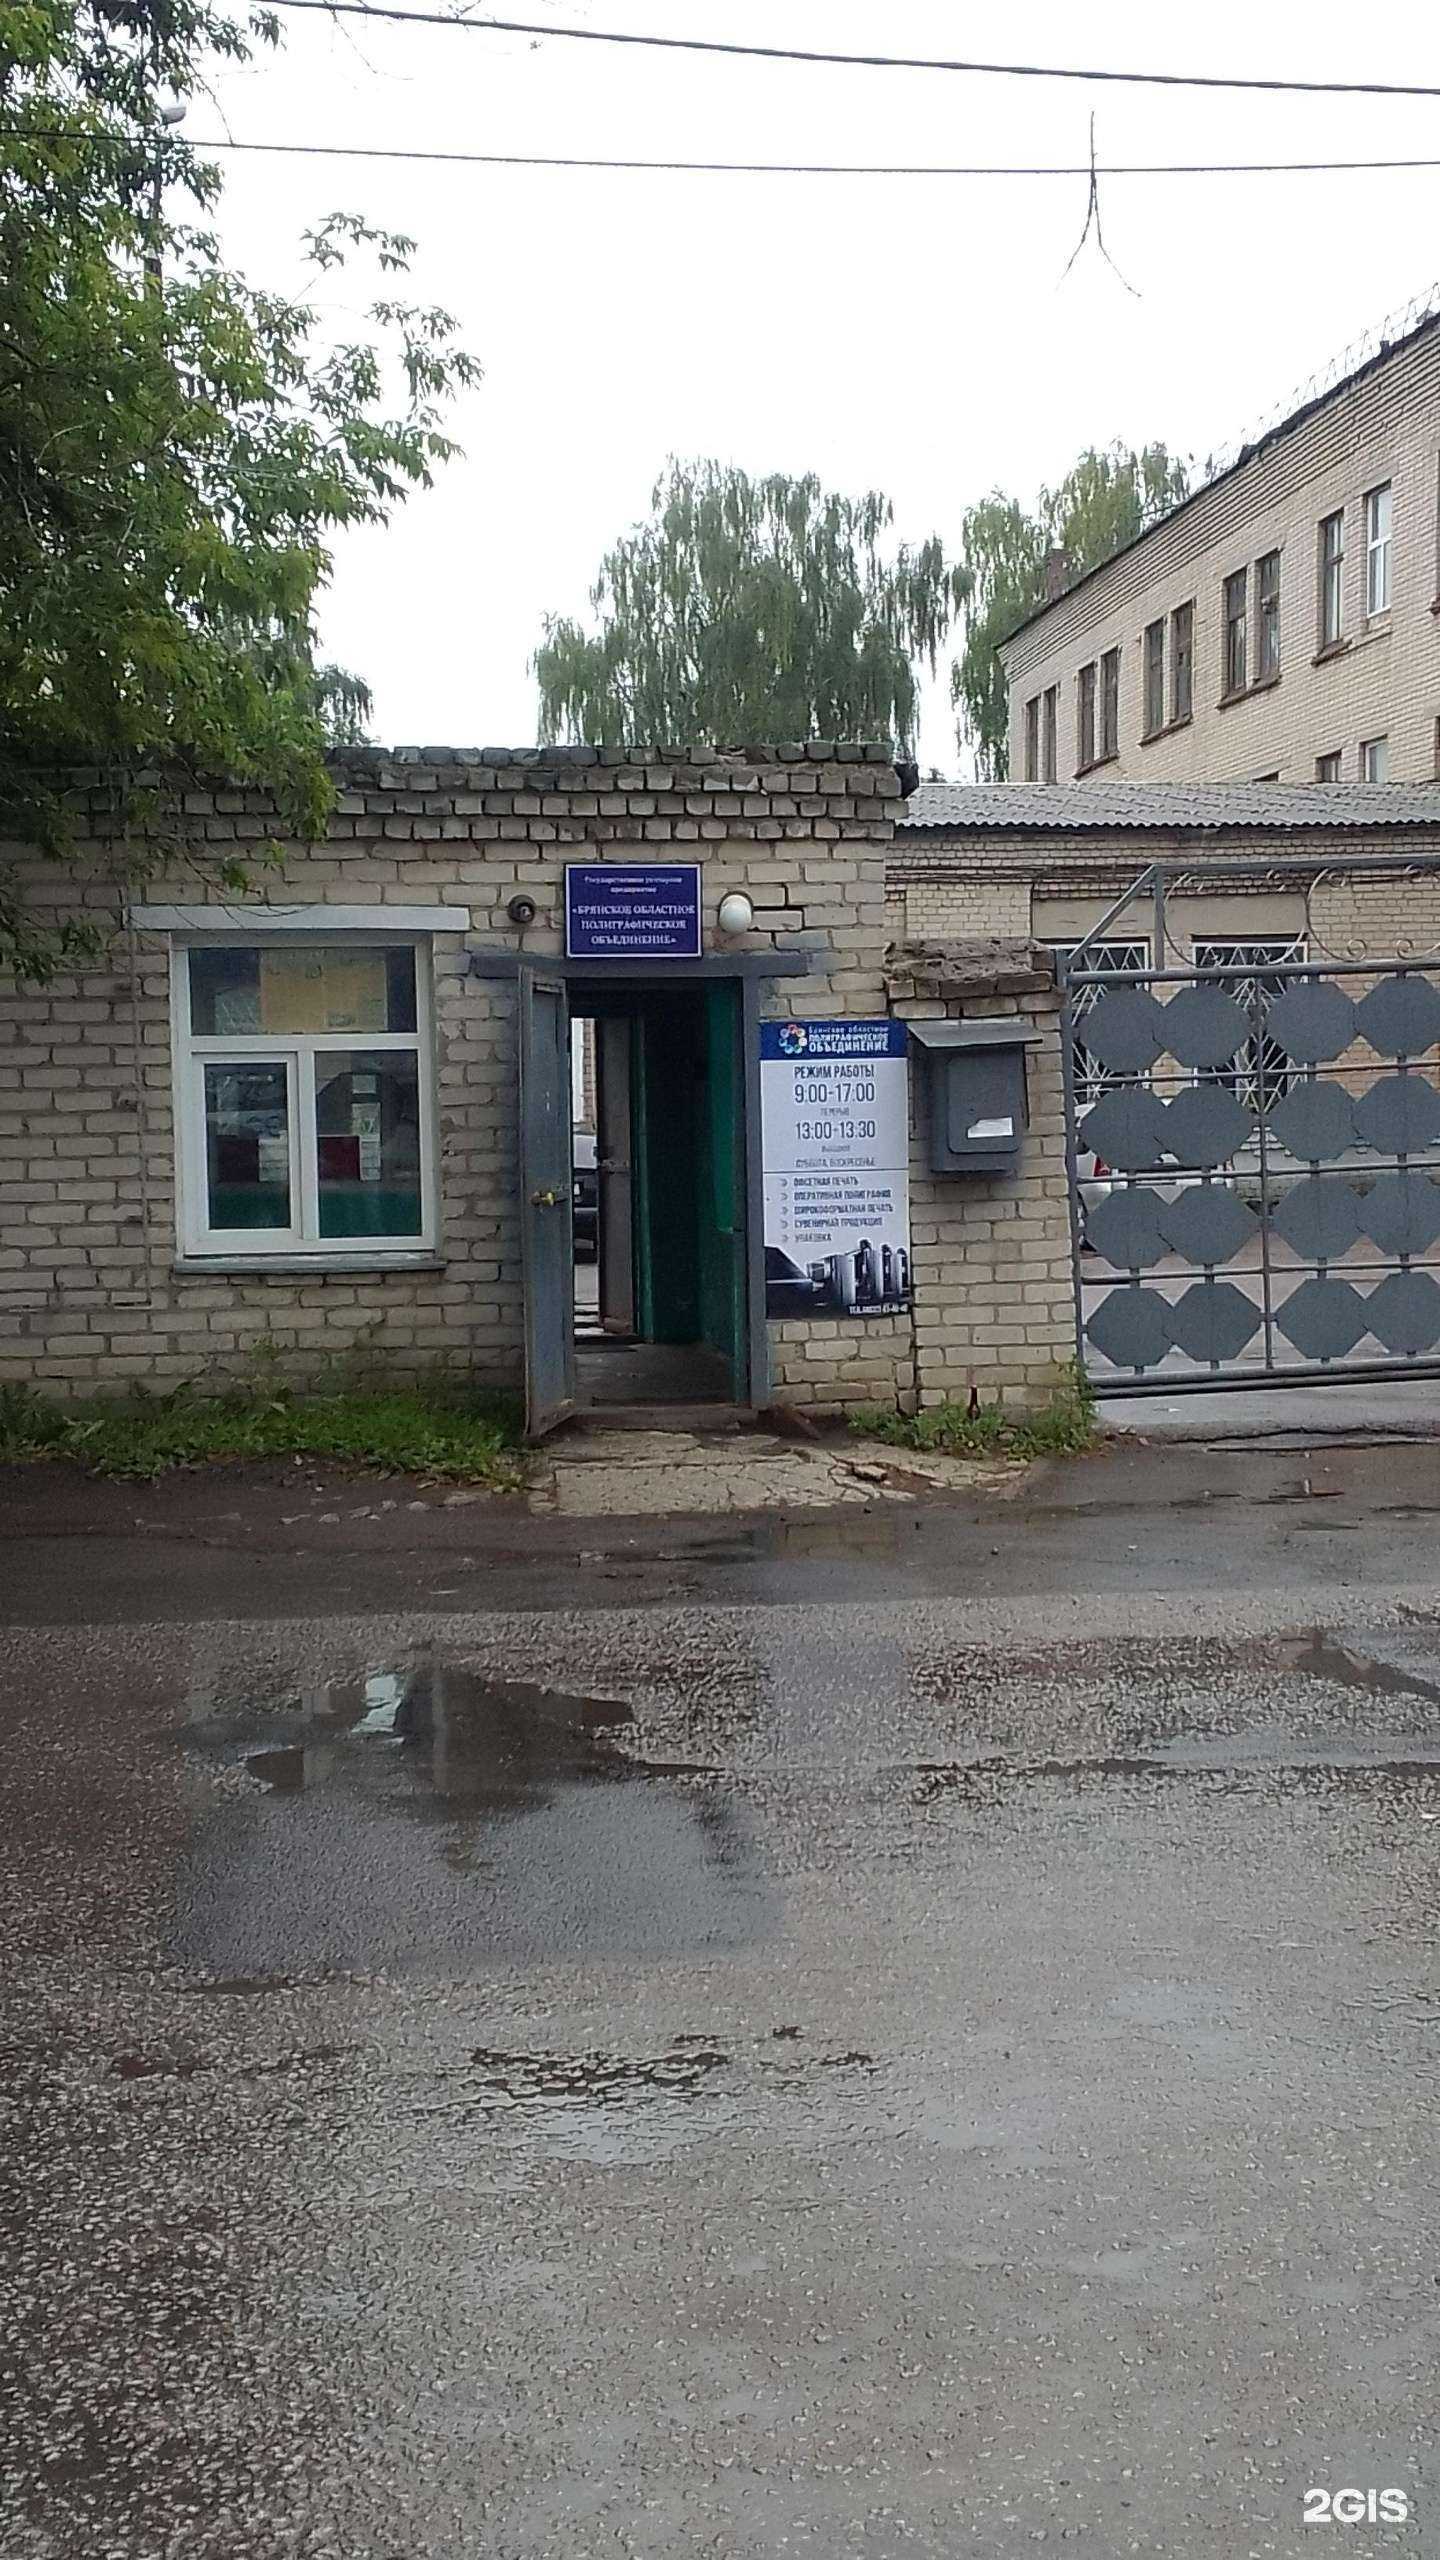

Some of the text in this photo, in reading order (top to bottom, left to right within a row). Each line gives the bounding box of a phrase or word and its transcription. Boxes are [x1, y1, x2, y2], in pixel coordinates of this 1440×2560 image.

[572, 905, 695, 914] «БРЯНСКОЕ ОБЛАСТНОЕ
[581, 919, 687, 929] ПОЛИГРАФИЧЕСКОЕ
[591, 935, 677, 944] ОБЪЕДИНЕНИЕ»
[808, 1033, 888, 1042] ПОЛИГРАФИЧЕСКОЕ
[808, 1041, 888, 1054] ОБЪЕДИНЕНИЕ
[794, 1064, 874, 1079] РЕЖИМ РАБОТЫ
[795, 1083, 875, 1103] 9:00-17:00
[796, 1120, 876, 1139] 13:00-13:30
[832, 1176, 858, 1185] ПЕЧАТЬ
[794, 1191, 842, 1200] ОПЕРАТИВНАЯ
[868, 1203, 893, 1213] ПЕЧАТЬ
[795, 1219, 839, 1228] СУВЕНИРНАЯ
